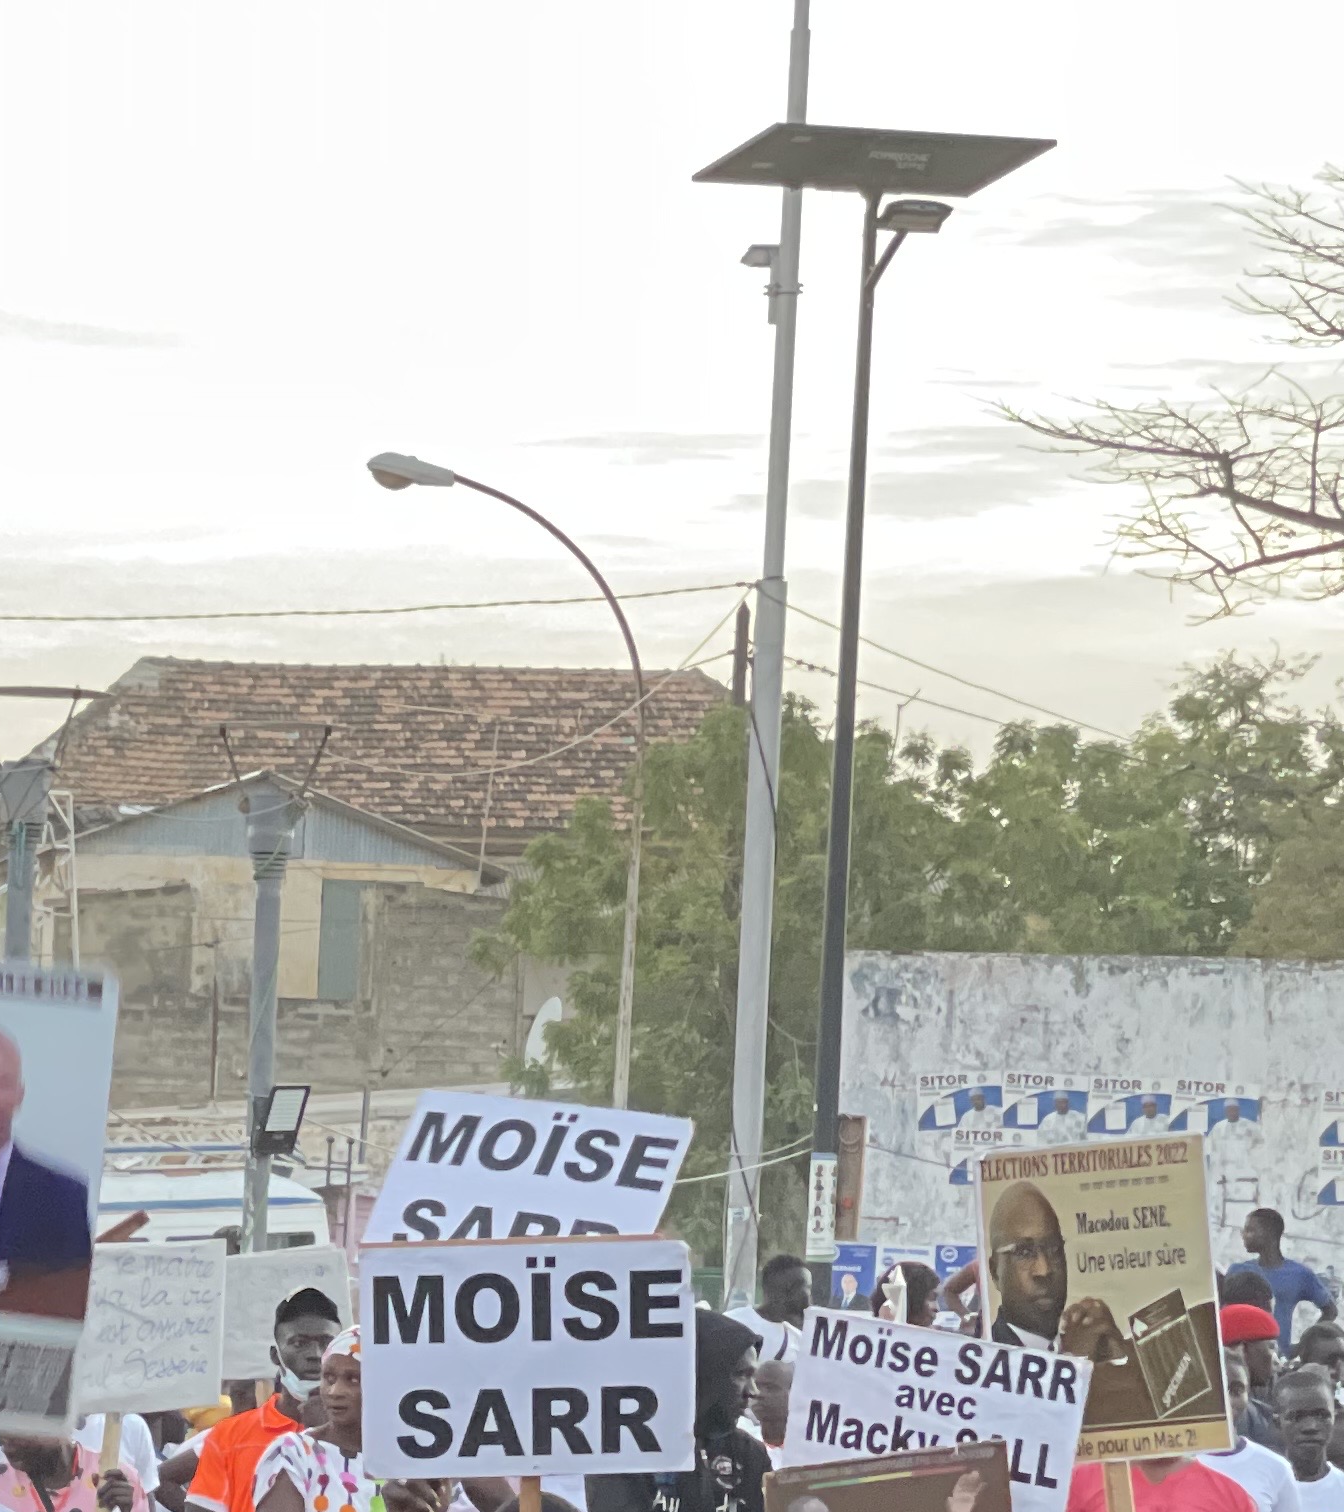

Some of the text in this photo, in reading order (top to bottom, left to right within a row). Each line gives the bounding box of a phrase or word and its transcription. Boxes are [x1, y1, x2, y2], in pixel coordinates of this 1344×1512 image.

[920, 1074, 968, 1087] SITOR
[1006, 1074, 1055, 1087] SITOR
[1094, 1078, 1142, 1090] SITOR
[1177, 1079, 1226, 1093] SITOR
[955, 1129, 1003, 1142] SITOR
[406, 1111, 679, 1192] MOÏSE
[980, 1156, 1049, 1183] ELECTIONS
[1052, 1145, 1153, 1175] TERRITORIALES
[1076, 1252, 1106, 1273] Une
[1108, 1246, 1153, 1271] valeur
[373, 1256, 683, 1345] MOÏSE
[809, 1316, 1078, 1404] Moïse SARR
[894, 1384, 978, 1420] avec
[396, 1385, 662, 1459] SARR
[1097, 1435, 1130, 1458] pour
[1133, 1434, 1151, 1451] un
[1153, 1429, 1183, 1449] Mac
